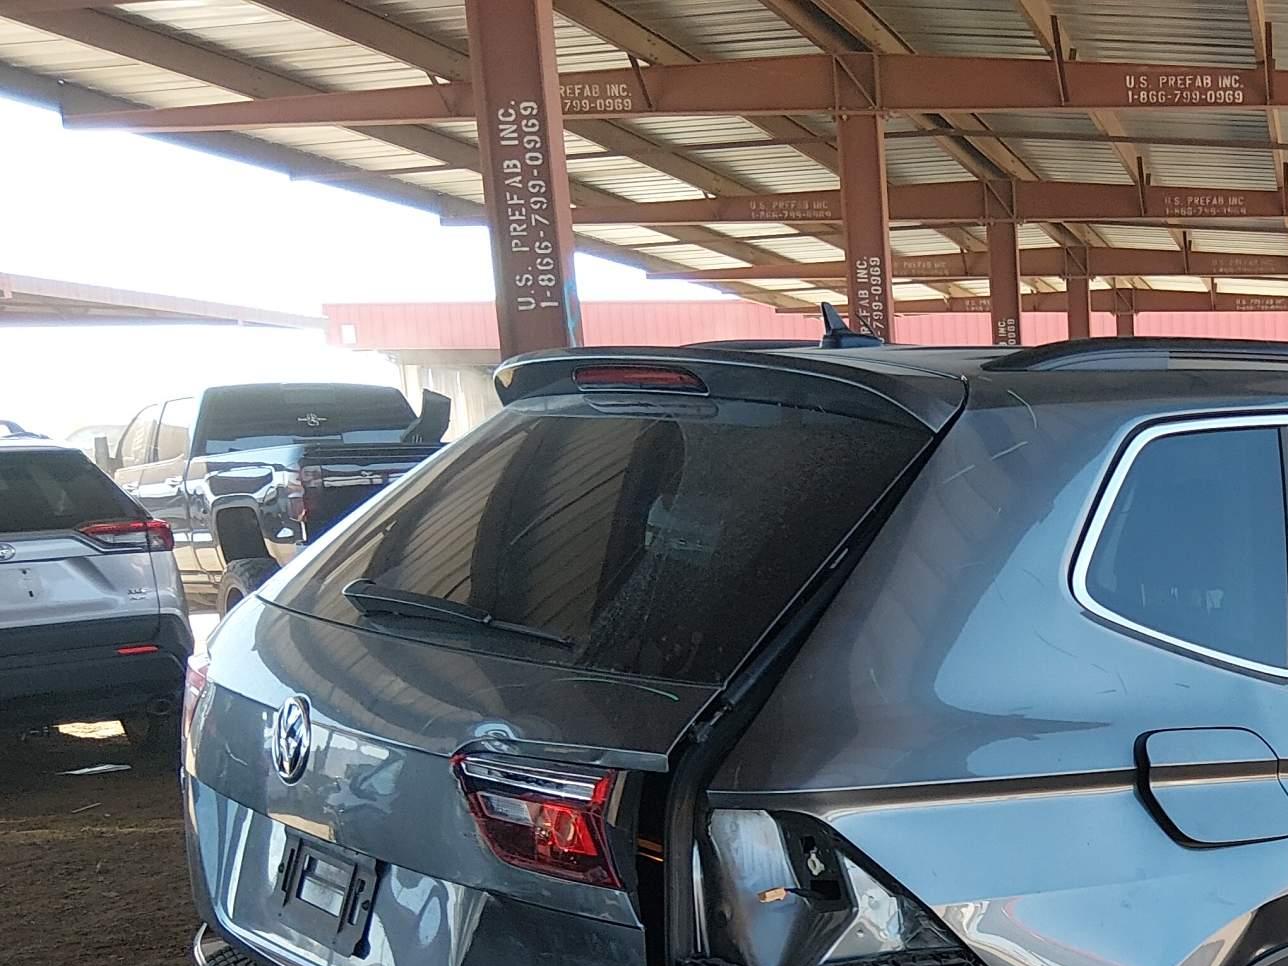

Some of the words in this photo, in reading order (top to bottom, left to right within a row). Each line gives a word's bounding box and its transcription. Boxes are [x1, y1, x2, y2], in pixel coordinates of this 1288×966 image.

[607, 84, 632, 97] INC.
[1126, 75, 1152, 88] U.S.
[1160, 75, 1212, 88] PREFAB
[1218, 75, 1244, 88] INC.
[1127, 90, 1243, 103] 1-866-799-0969
[498, 100, 519, 146] INC.
[503, 159, 530, 252] PREFAB
[519, 101, 559, 308] 1-866-799-0969
[856, 256, 869, 282] INC.
[515, 266, 536, 311] U.S.
